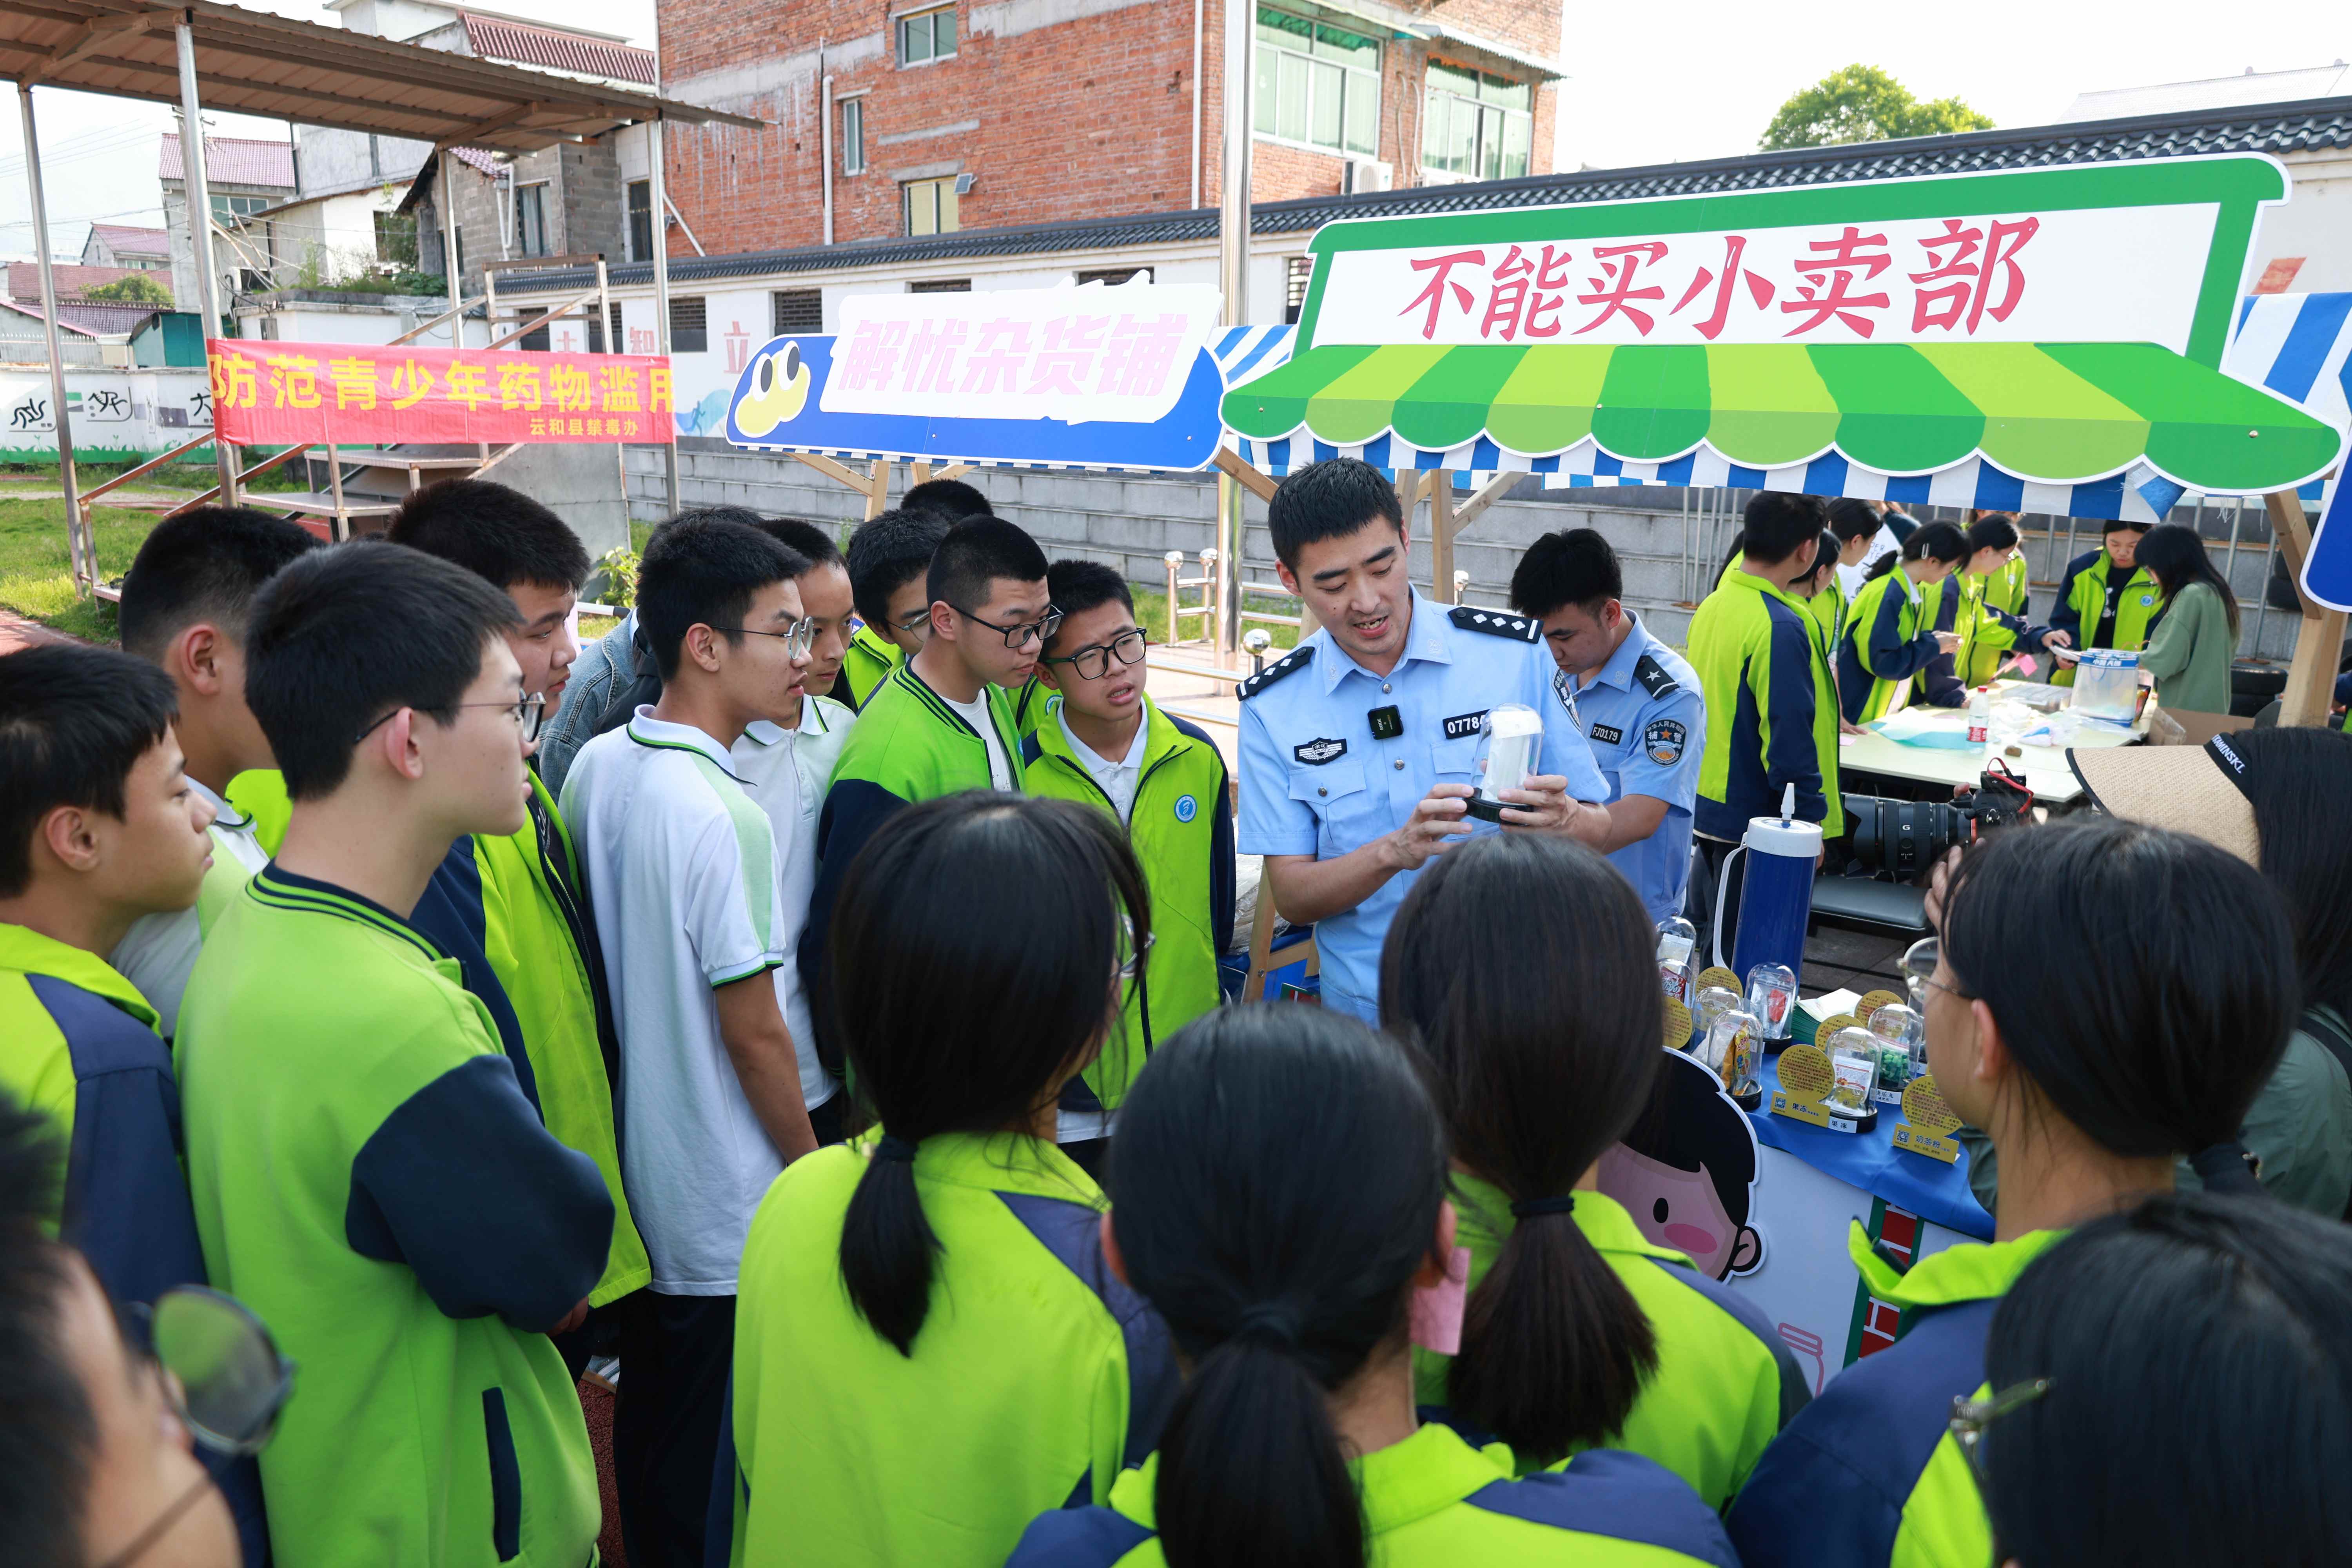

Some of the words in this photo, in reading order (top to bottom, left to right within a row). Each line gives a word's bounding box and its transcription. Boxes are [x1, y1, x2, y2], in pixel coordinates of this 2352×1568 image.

[1396, 216, 2041, 341] 不能买小卖部
[838, 313, 1188, 397] 解忧杂货铺
[530, 418, 639, 437] 云和县禁毒办
[1592, 726, 1618, 741] FJ0179
[1646, 721, 1685, 735] 中华人民共和国
[1792, 1102, 1808, 1112] 果冻
[1831, 1120, 1847, 1129] 果冻
[1916, 1135, 1940, 1149] 奶茶粉
